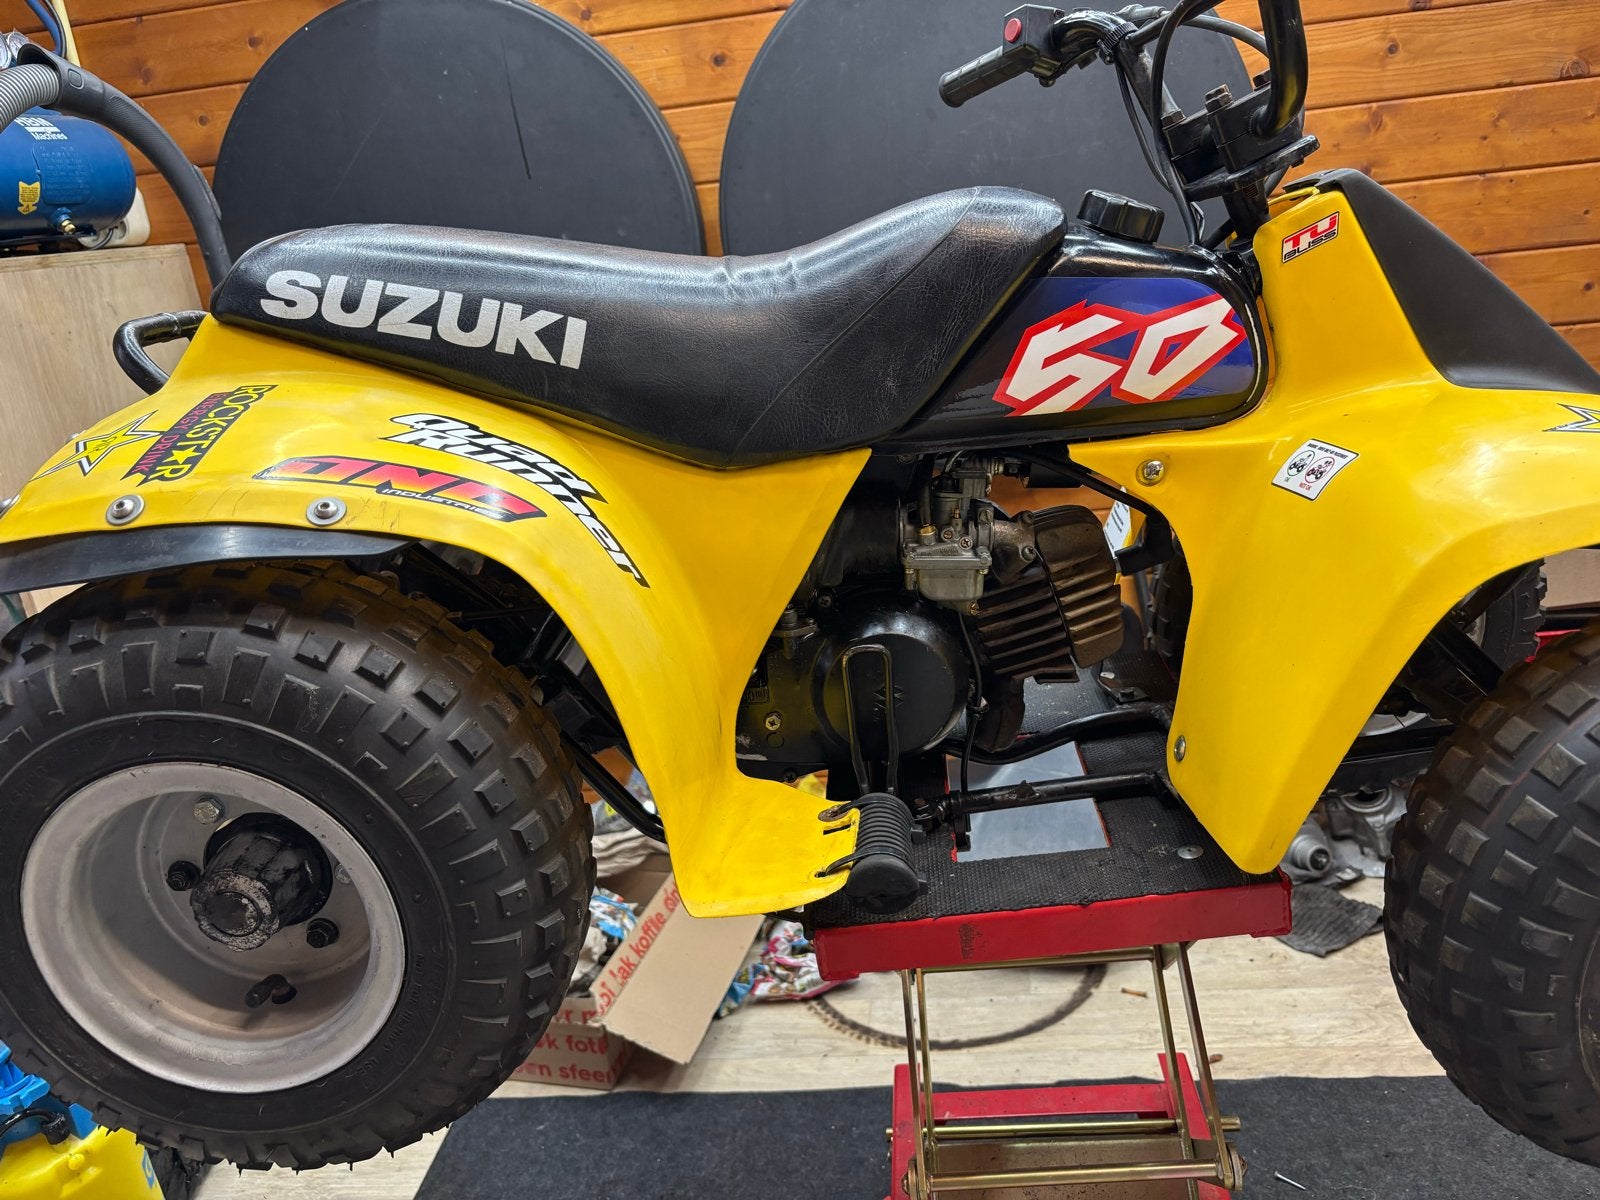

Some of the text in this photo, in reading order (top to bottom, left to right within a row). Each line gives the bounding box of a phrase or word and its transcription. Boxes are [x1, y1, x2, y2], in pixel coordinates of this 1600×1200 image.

[260, 270, 588, 370] SUZUKI
[1000, 295, 1243, 417] 50
[132, 393, 228, 473] ENERGY DRINK
[389, 413, 604, 500] Quad
[383, 428, 646, 585] Runner
[628, 912, 666, 959] koffie
